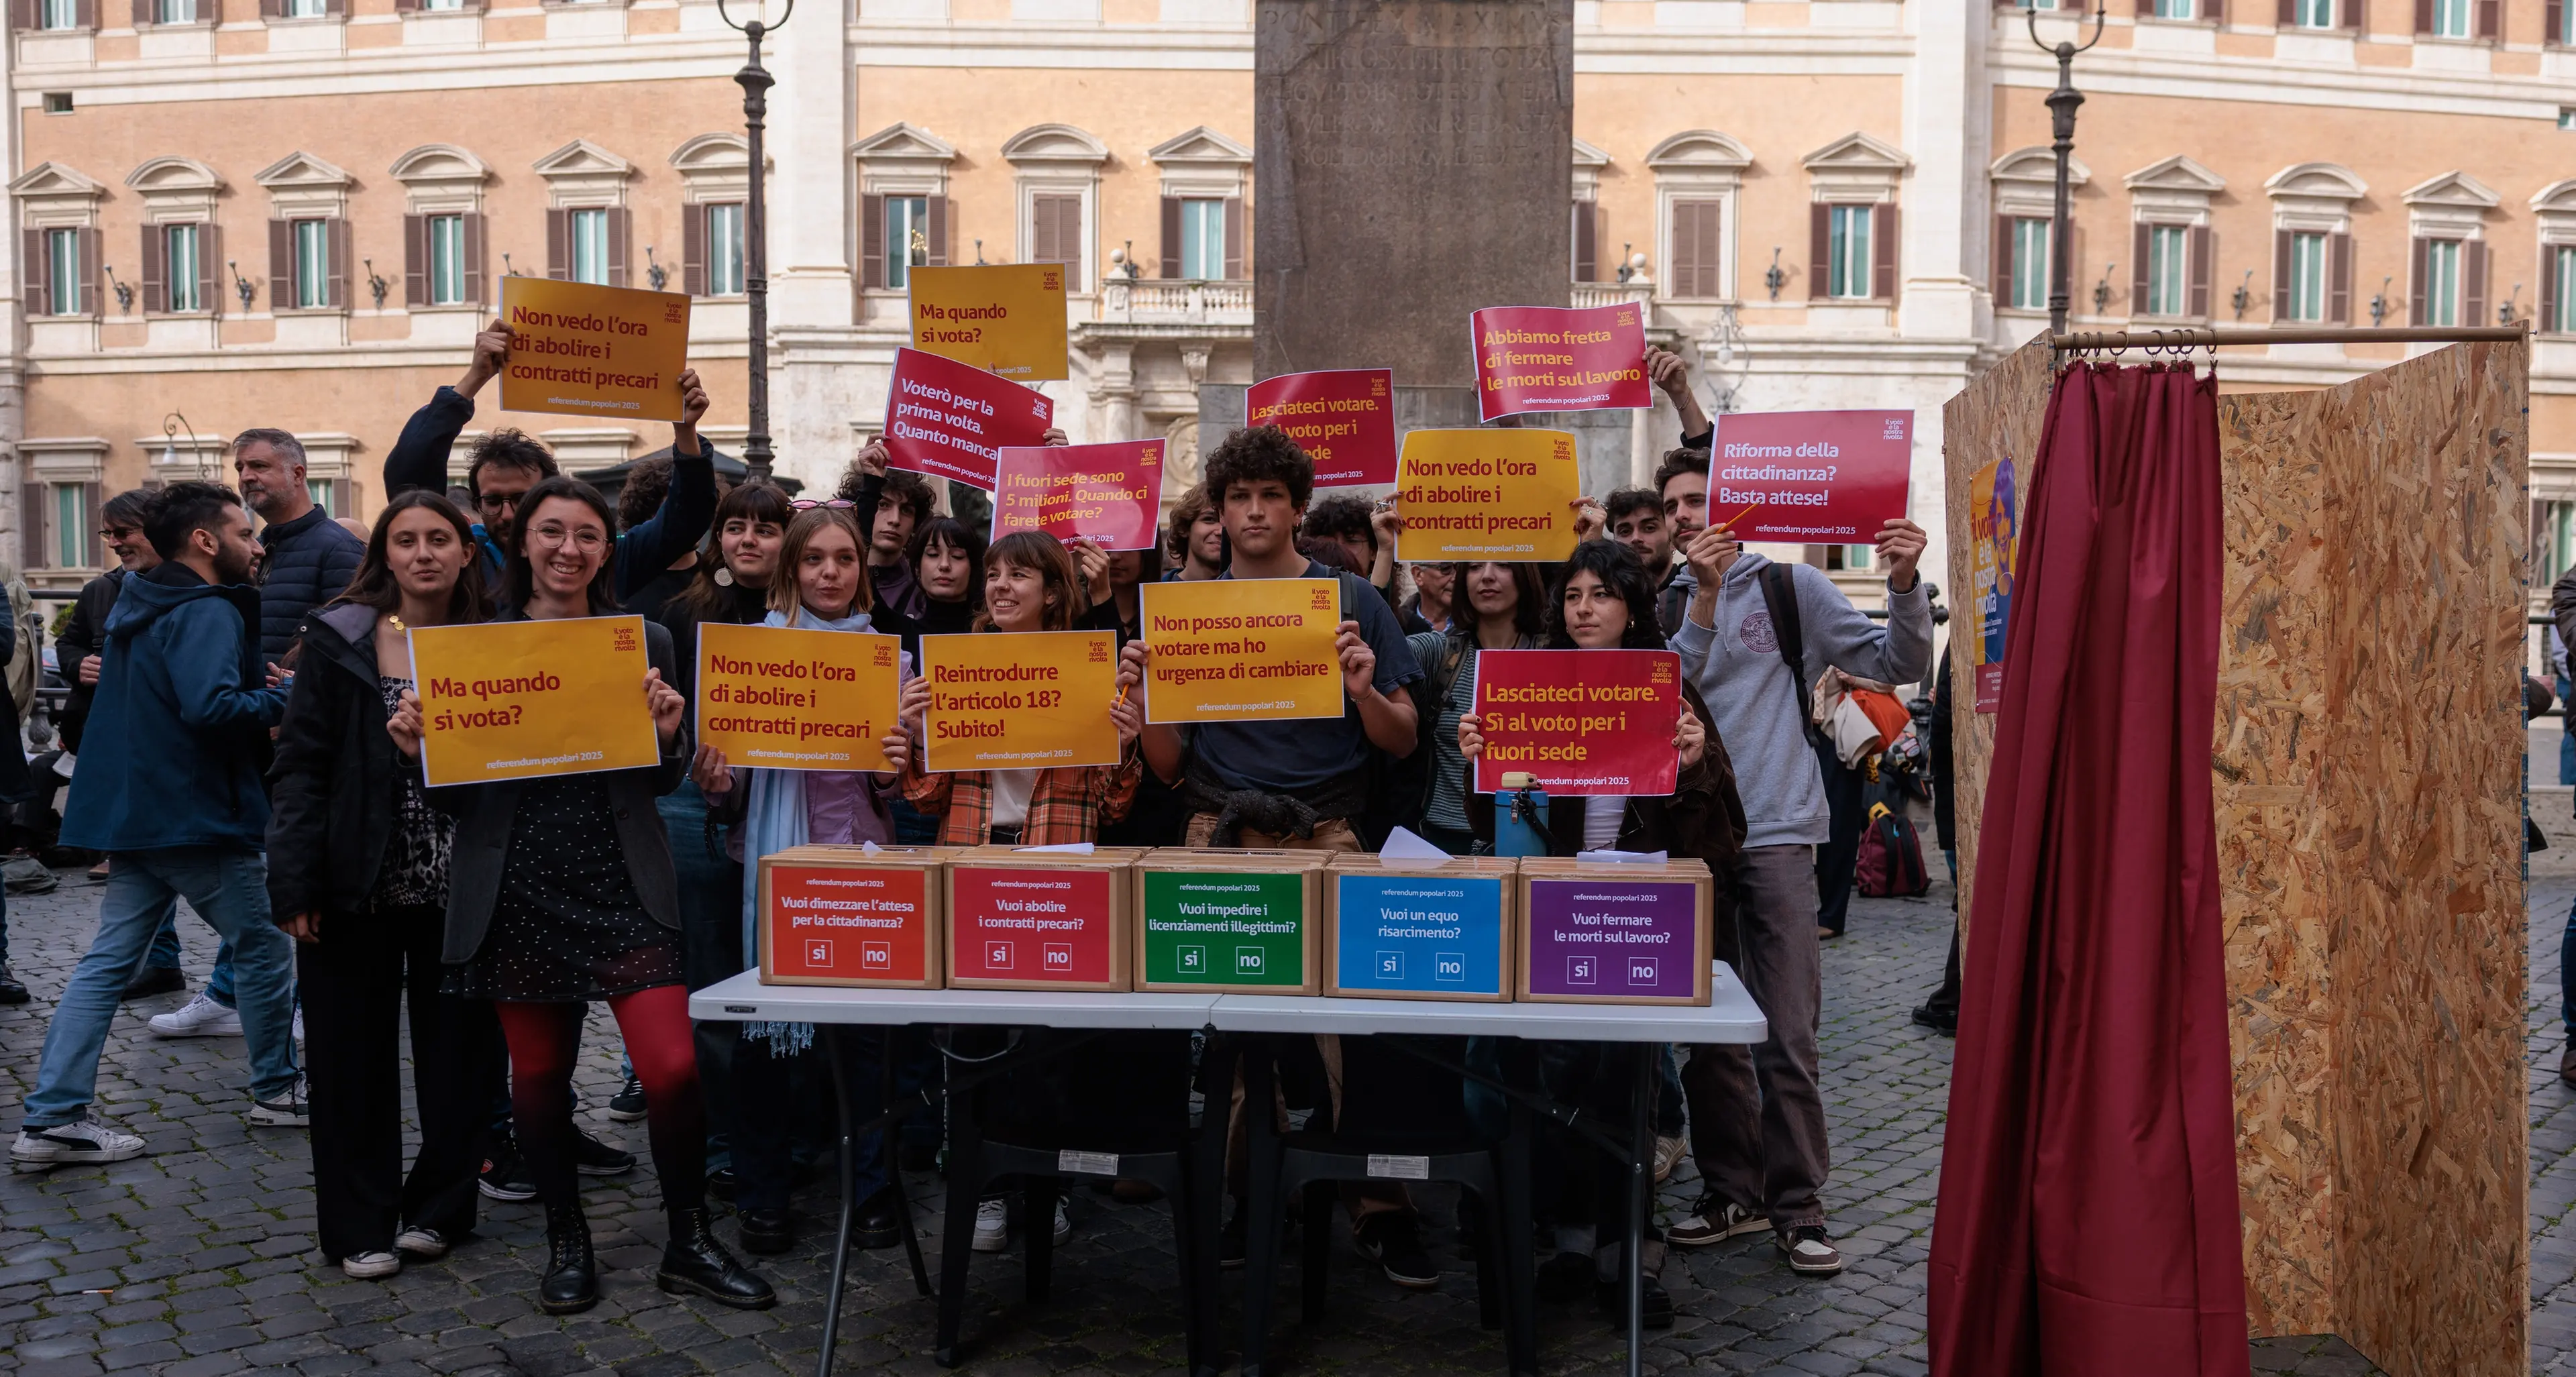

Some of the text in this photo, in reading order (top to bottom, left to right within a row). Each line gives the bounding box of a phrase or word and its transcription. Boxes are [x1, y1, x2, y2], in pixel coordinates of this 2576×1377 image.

[512, 306, 647, 336] Non vedo l'ora
[921, 303, 1006, 323] Ma quando
[922, 327, 981, 343] si vota?
[1483, 329, 1611, 347] Abbiamo fretta
[511, 333, 610, 359] di abolire i
[1483, 349, 1573, 371] di fermare
[512, 366, 658, 390] contratti precari
[1488, 368, 1641, 390] le morti sul lavoro
[902, 378, 993, 416] Voterò per la
[1562, 396, 1591, 404] popolari
[896, 402, 983, 435] prima volta.
[1252, 397, 1379, 421] Lasciateci votare.
[894, 421, 949, 444] Quanto
[1285, 423, 1356, 439] voto per i
[1725, 443, 1839, 457] Riforma della
[1407, 459, 1536, 476] Non vedo l'ora
[1721, 465, 1836, 480] cittadinanza?
[1008, 472, 1124, 487] I fuori sede sono
[1006, 486, 1147, 509] 5 milioni. Quando ci
[1406, 486, 1500, 503] di abolire i
[1720, 488, 1828, 506] Basta attese!
[1004, 507, 1103, 527] farete votare?
[1406, 512, 1551, 535] contratti precari
[1756, 525, 1801, 533] referendum
[1802, 527, 1833, 535] popolari
[1972, 512, 1978, 543] il
[1979, 538, 1991, 565] è la
[1975, 566, 1996, 590] nostra
[1976, 588, 1996, 616] rivolta
[1155, 615, 1302, 635] Non posso ancora
[1155, 637, 1265, 656] votare ma ho
[712, 655, 855, 681] Non vedo l'ora
[935, 663, 1058, 683] Reintrodurre
[1157, 660, 1328, 685] urgenza di cambiare
[431, 671, 560, 701] Ma quando
[1487, 682, 1659, 702] Lasciateci votare.
[710, 684, 815, 708] di abolire i
[936, 690, 1061, 710] l'articolo 18?
[435, 705, 522, 730] si vota?
[1486, 712, 1625, 736] Sì al voto per i
[708, 716, 869, 741] contratti precari
[937, 719, 1004, 738] Subito!
[1486, 742, 1587, 760] fuori sede
[782, 897, 914, 912] Vuoi dimezzare l'attesa
[996, 899, 1066, 913] Vuoi abolire
[1179, 903, 1267, 918] Vuoi impedire i
[793, 914, 903, 928] per la cittadinanza?
[979, 916, 1083, 932] i contratti precari?
[1381, 908, 1458, 924] Vuoi un equo
[1572, 913, 1652, 926] Vuoi fermare
[1150, 919, 1296, 936] licenziamenti illegittimi?
[1379, 925, 1460, 938] risarcimento?
[1555, 930, 1670, 943] le morti sul lavoro?
[813, 945, 886, 961] si no
[994, 946, 1068, 963] si no
[1185, 951, 1260, 967] si no
[1384, 956, 1460, 973] si no
[1575, 961, 1654, 978] si no
